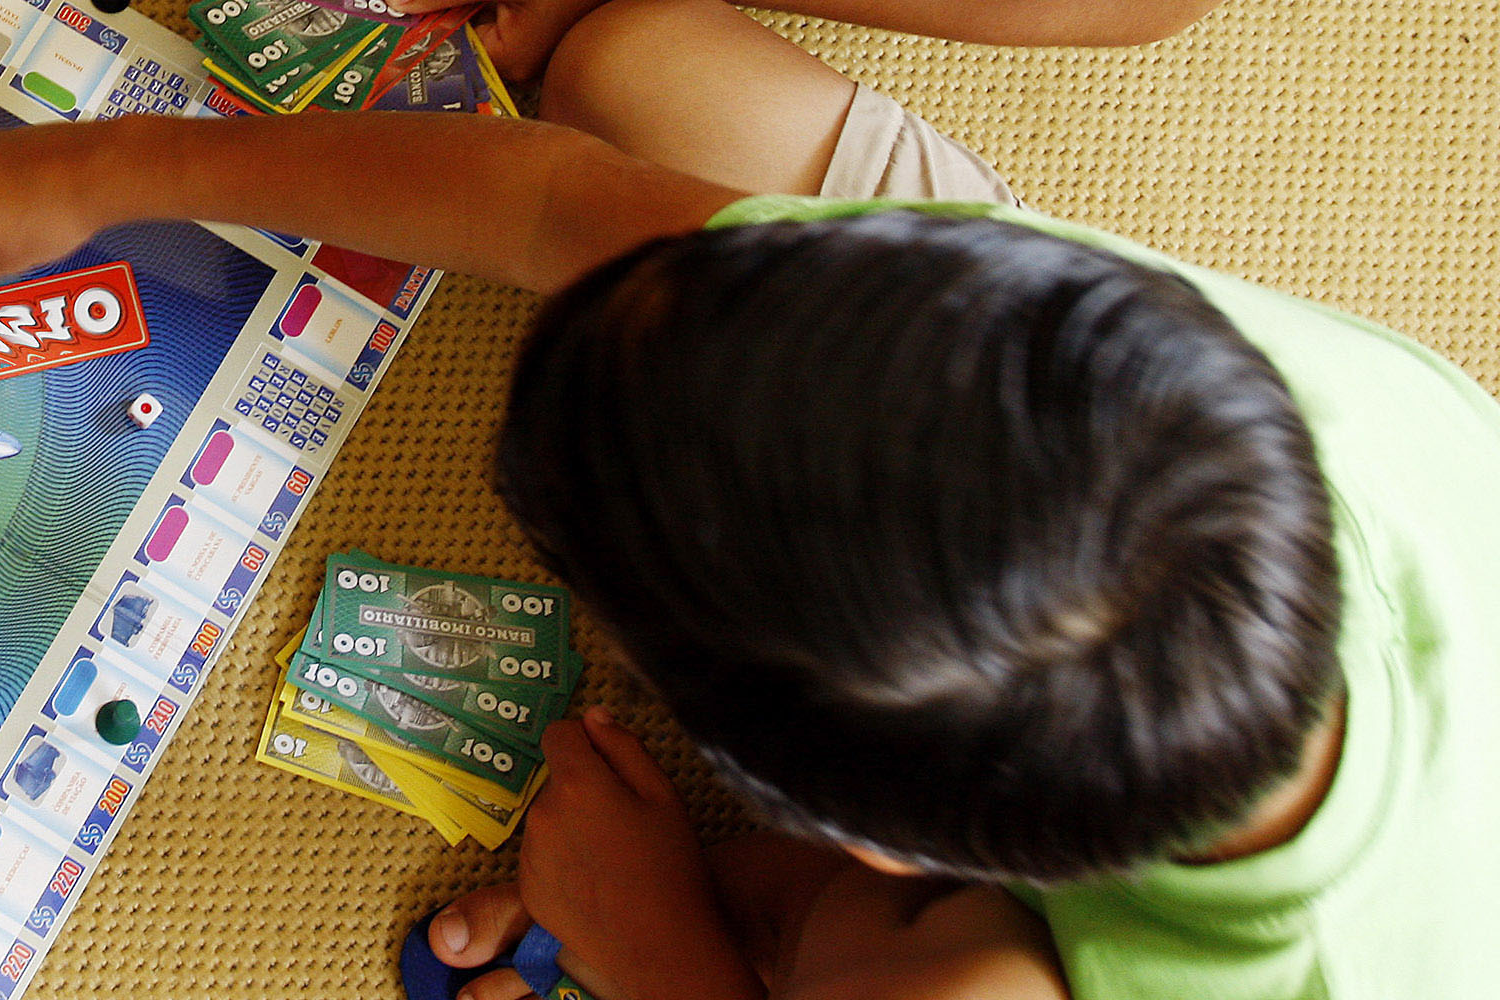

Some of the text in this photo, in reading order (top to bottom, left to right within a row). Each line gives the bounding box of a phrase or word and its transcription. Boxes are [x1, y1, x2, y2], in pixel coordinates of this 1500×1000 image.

[60, 5, 91, 30] 300
[247, 39, 290, 69] 100
[334, 70, 363, 104] 100
[394, 264, 430, 310] PARTI
[369, 323, 396, 353] 100
[287, 471, 309, 494] 60
[243, 547, 265, 570] 60
[337, 569, 390, 594] 100
[501, 592, 554, 616] 100
[193, 623, 219, 655] 200
[363, 609, 531, 642] BANCO IMOBILIARIO
[333, 632, 386, 657] 100
[304, 662, 360, 697] 100
[499, 656, 551, 679] 100
[147, 700, 175, 733] 240
[475, 691, 529, 724] 100
[273, 734, 307, 758] 10
[460, 738, 514, 772] 100
[99, 779, 129, 813] 200
[52, 861, 81, 896] 220
[2, 944, 31, 979] 220
